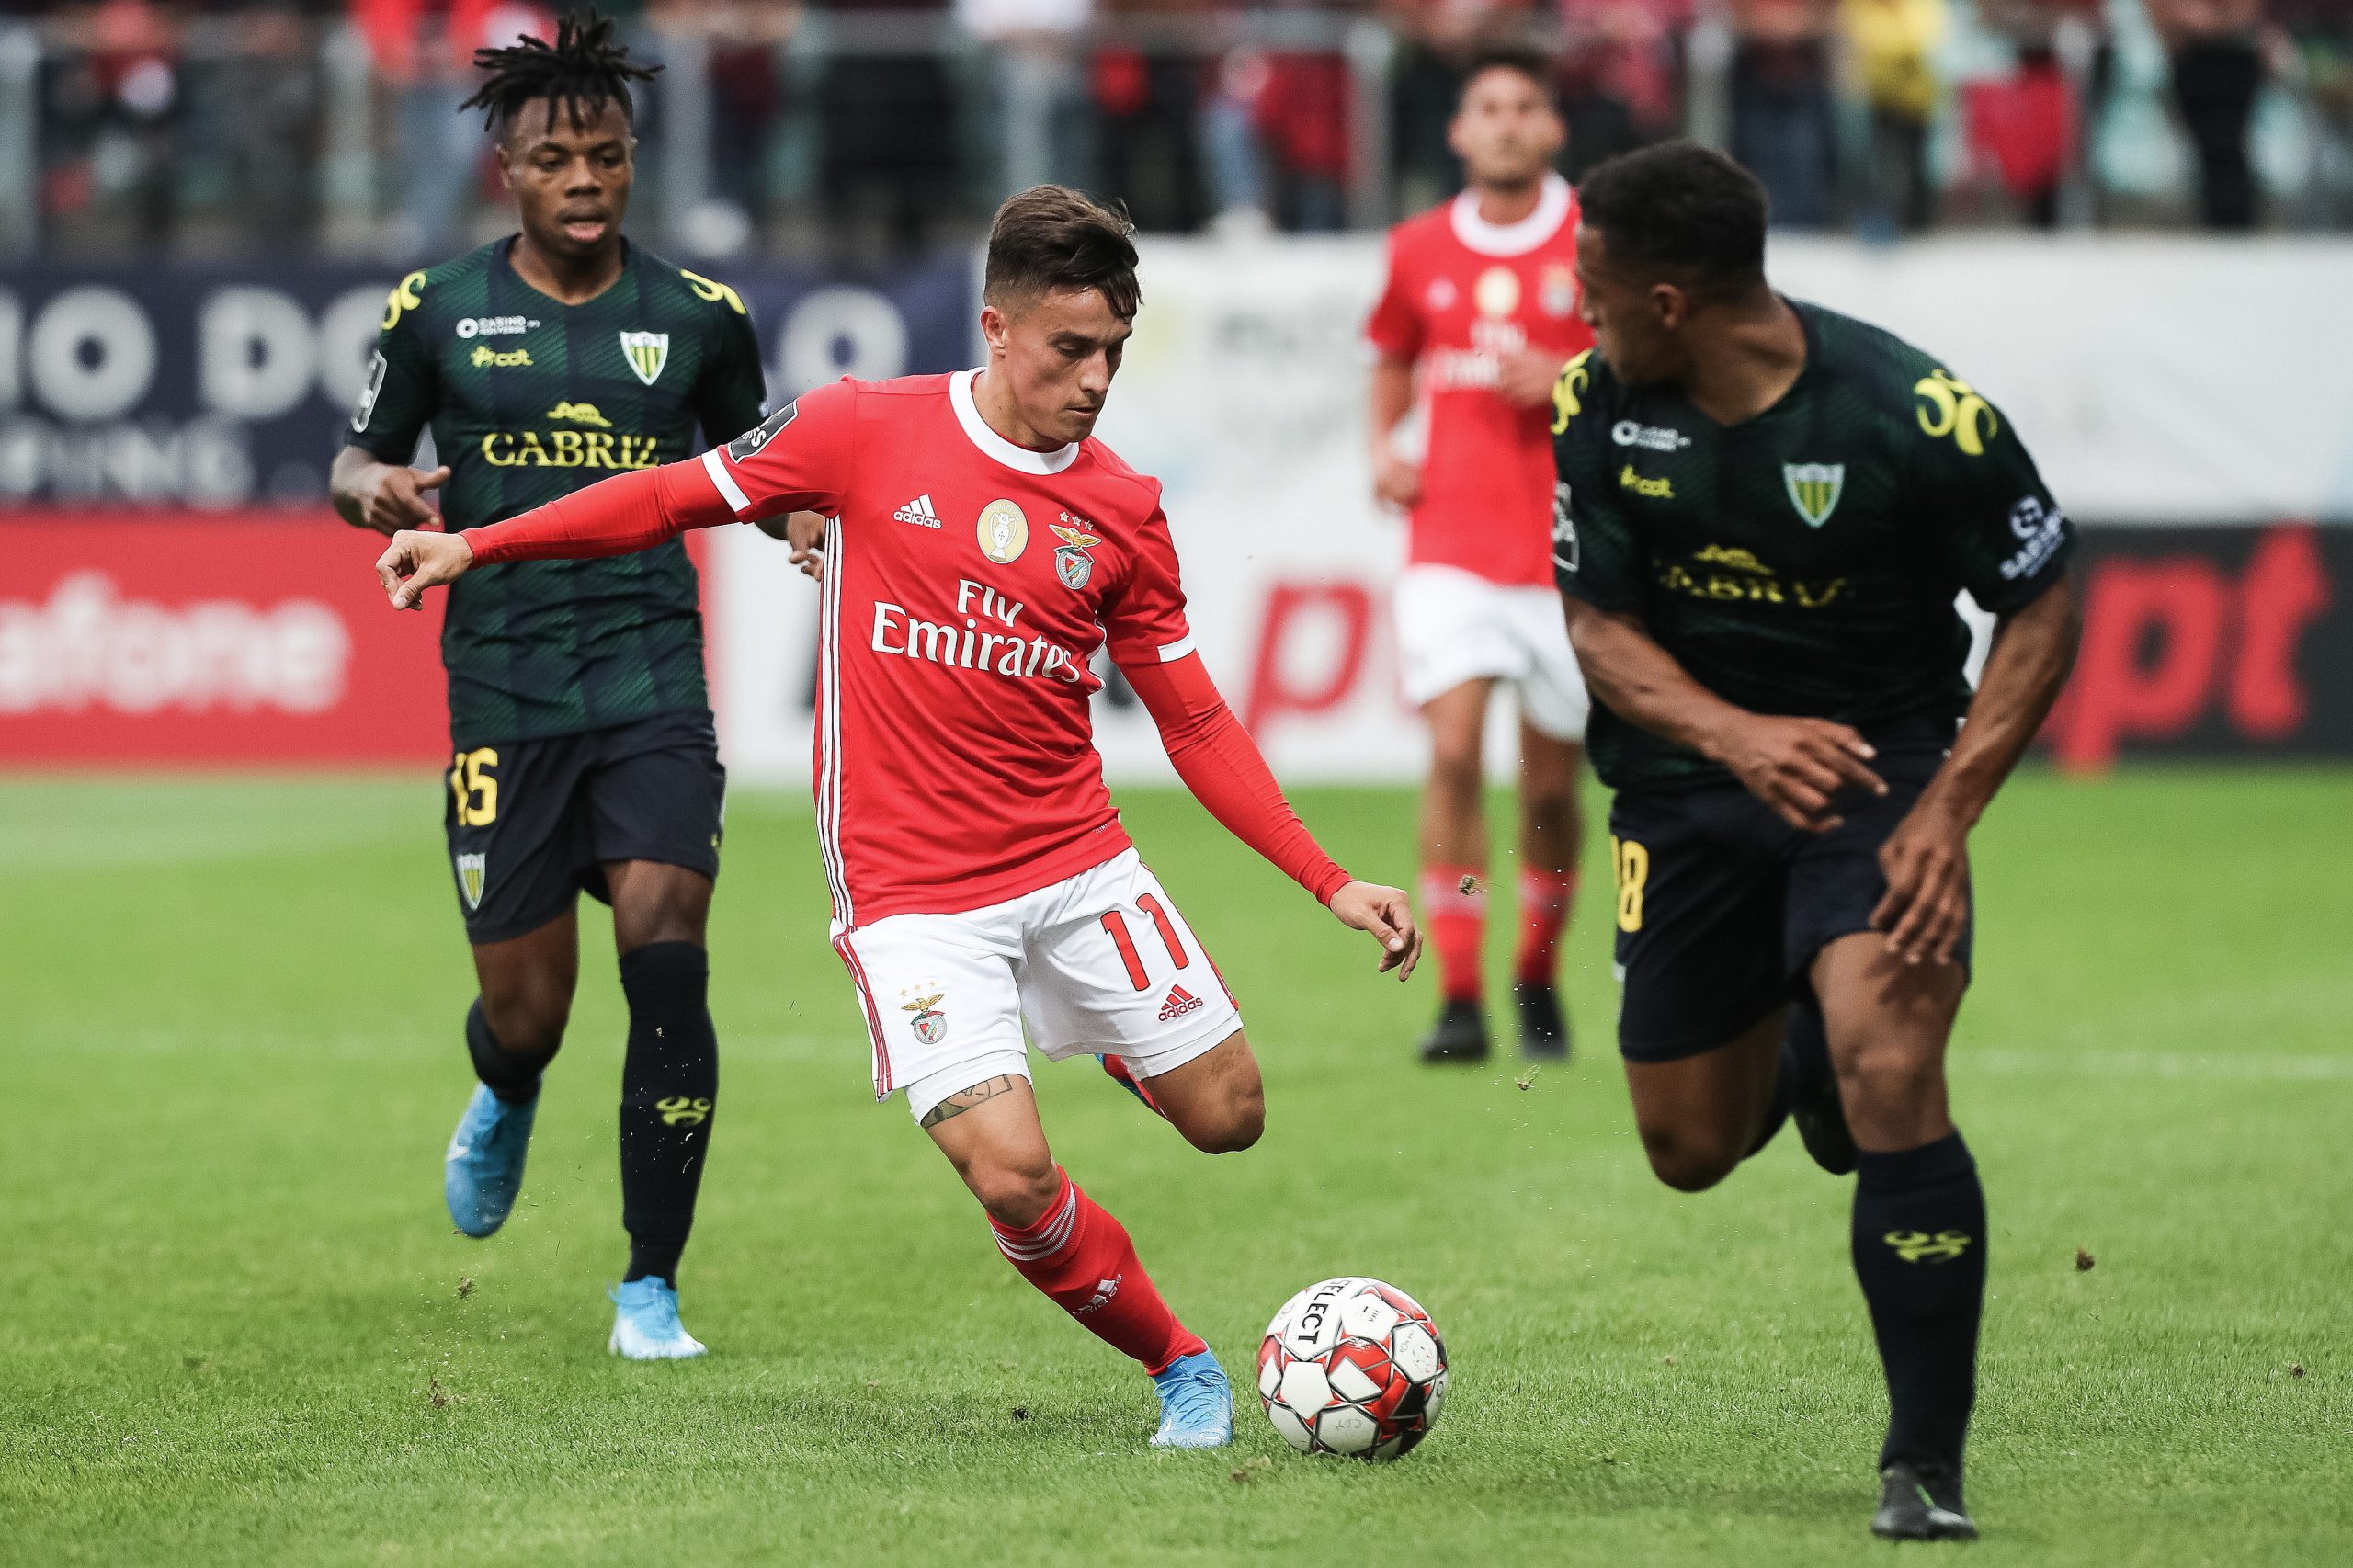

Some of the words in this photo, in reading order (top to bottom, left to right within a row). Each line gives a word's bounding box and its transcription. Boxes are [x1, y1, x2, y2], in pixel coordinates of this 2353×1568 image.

[481, 430, 661, 470] CABRIZ
[892, 510, 942, 530] adidas
[957, 578, 1025, 628] Fly
[870, 600, 1081, 683] Emirates
[449, 747, 499, 827] 15
[1100, 892, 1190, 992] 11
[1158, 997, 1204, 1022] adidas
[1298, 1279, 1353, 1345] SELECT
